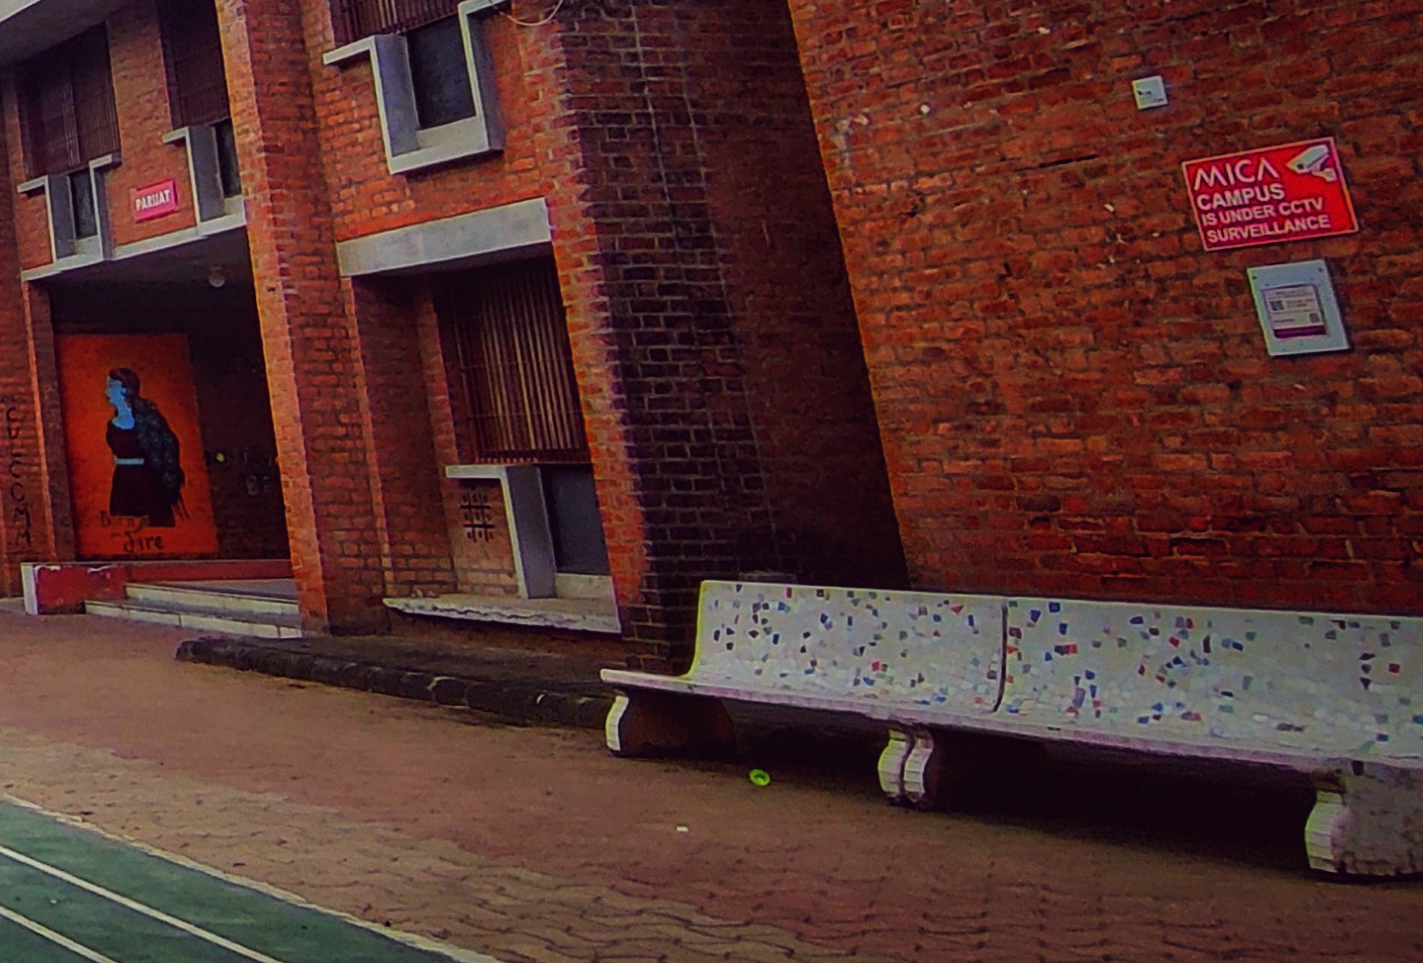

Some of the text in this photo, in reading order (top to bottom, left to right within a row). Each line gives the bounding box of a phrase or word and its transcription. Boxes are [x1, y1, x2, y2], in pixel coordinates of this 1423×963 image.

[1194, 157, 1281, 191] MICA
[1196, 182, 1286, 211] CAMPUS
[1201, 197, 1324, 227] IS UNDER CCTV
[1206, 215, 1333, 244] SURVEILLANCE
